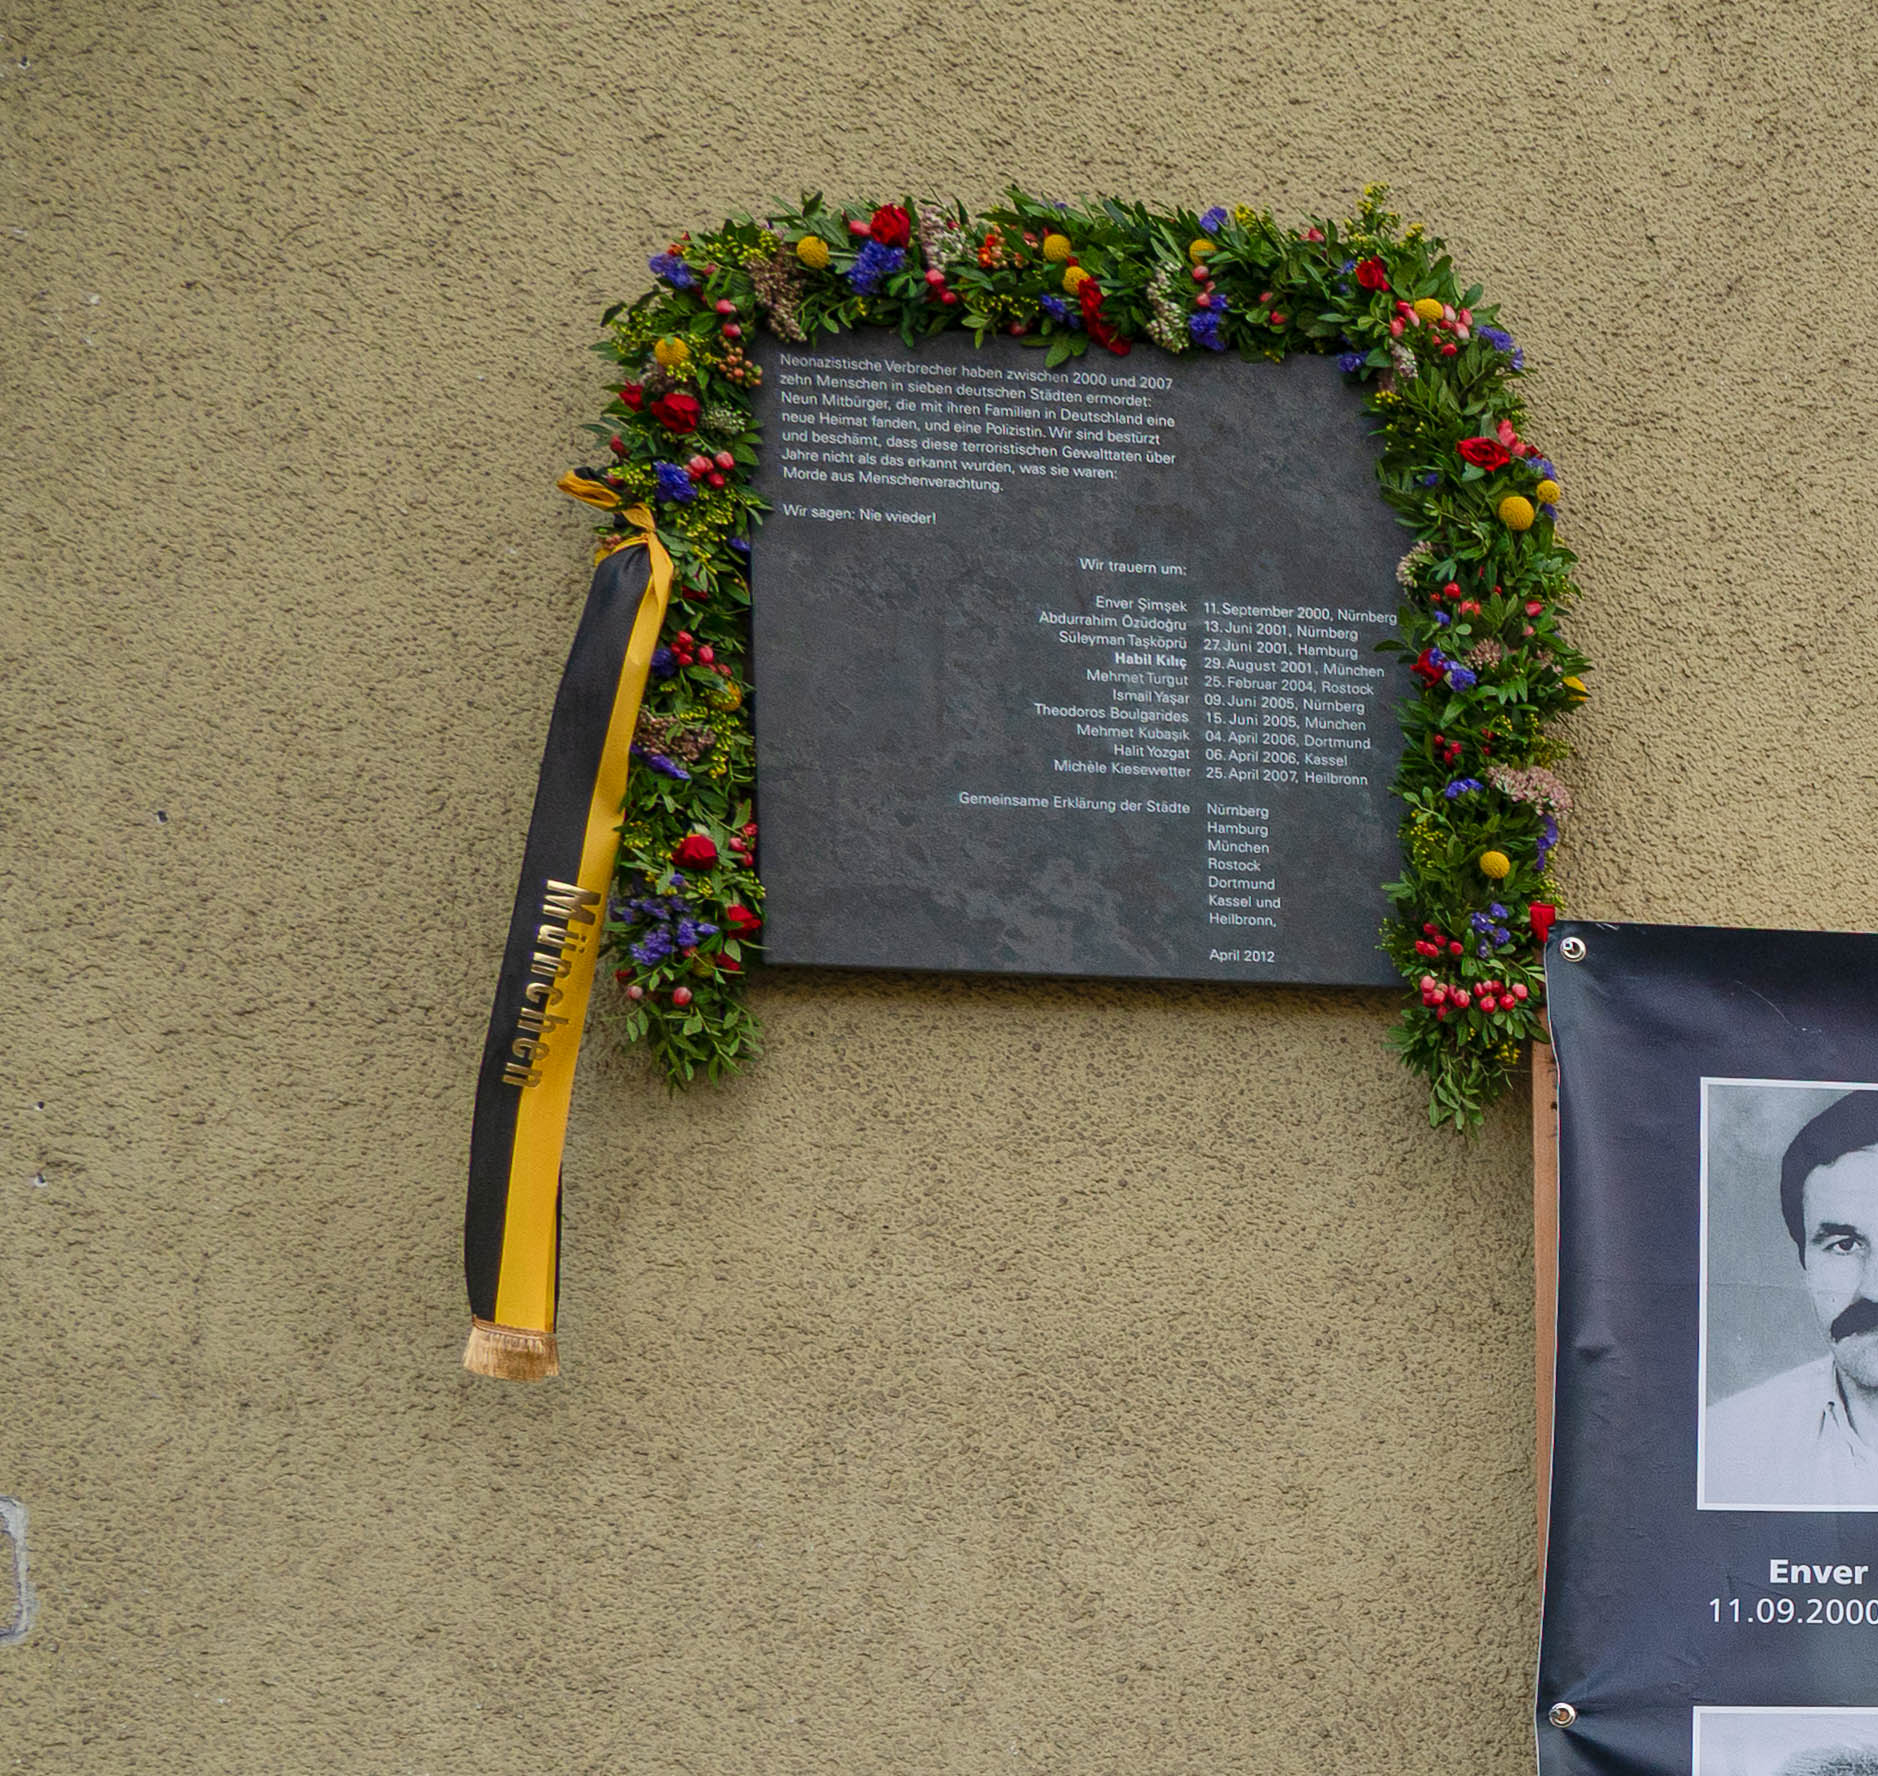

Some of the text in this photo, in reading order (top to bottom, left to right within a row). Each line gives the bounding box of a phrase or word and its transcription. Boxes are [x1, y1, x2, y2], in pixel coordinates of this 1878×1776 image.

[781, 354, 1172, 389] Neonazistische Verbrecher haben zwischen 2000 und 2007
[780, 374, 811, 385] zehn
[817, 375, 887, 390] Menschen
[908, 382, 952, 394] sieben
[956, 384, 1025, 398] deutschen
[1031, 388, 1082, 402] Städten
[1086, 394, 1151, 407] ermordet:
[782, 391, 817, 404] Neun
[896, 399, 916, 411] die
[921, 401, 942, 412] mit
[948, 402, 980, 414] ihren
[985, 404, 1040, 418] Familien
[1045, 411, 1056, 419] in
[1061, 408, 1142, 425] Deutschland
[1147, 417, 1175, 427] eine
[782, 413, 815, 423] neue
[820, 412, 867, 427] Heimat
[872, 416, 920, 431] fanden,
[925, 420, 950, 431] und
[954, 424, 981, 433] eine
[1049, 426, 1072, 438] Wir
[1076, 430, 1103, 441] sind
[1108, 430, 1160, 445] bestürzt
[783, 431, 1175, 464] und beschämt, dass diese terroristischen Gewalttaten über
[782, 448, 1117, 479] Jahre nicht als das erkannt wurden, was sie waren:
[784, 467, 827, 480] Morde
[831, 472, 854, 482] aus
[783, 504, 936, 524] Wir sagen: Nie wieder!
[1080, 558, 1186, 575] Wir trauern um:
[1096, 596, 1133, 609] Enver
[1115, 652, 1151, 665] Habil
[1087, 669, 1188, 687] Mehmet Turgut
[1034, 703, 1189, 722] Theodoros Boulgarides
[1207, 803, 1268, 819] Nürnberg
[1208, 822, 1268, 838] Hamburg
[1208, 840, 1269, 853] München
[1208, 858, 1260, 871] Rostock
[1209, 876, 1275, 890] Dortmund
[1209, 895, 1280, 908] Kassel und
[1210, 949, 1274, 962] April 2012
[502, 880, 601, 1087] München
[1770, 1560, 1868, 1584] Enver
